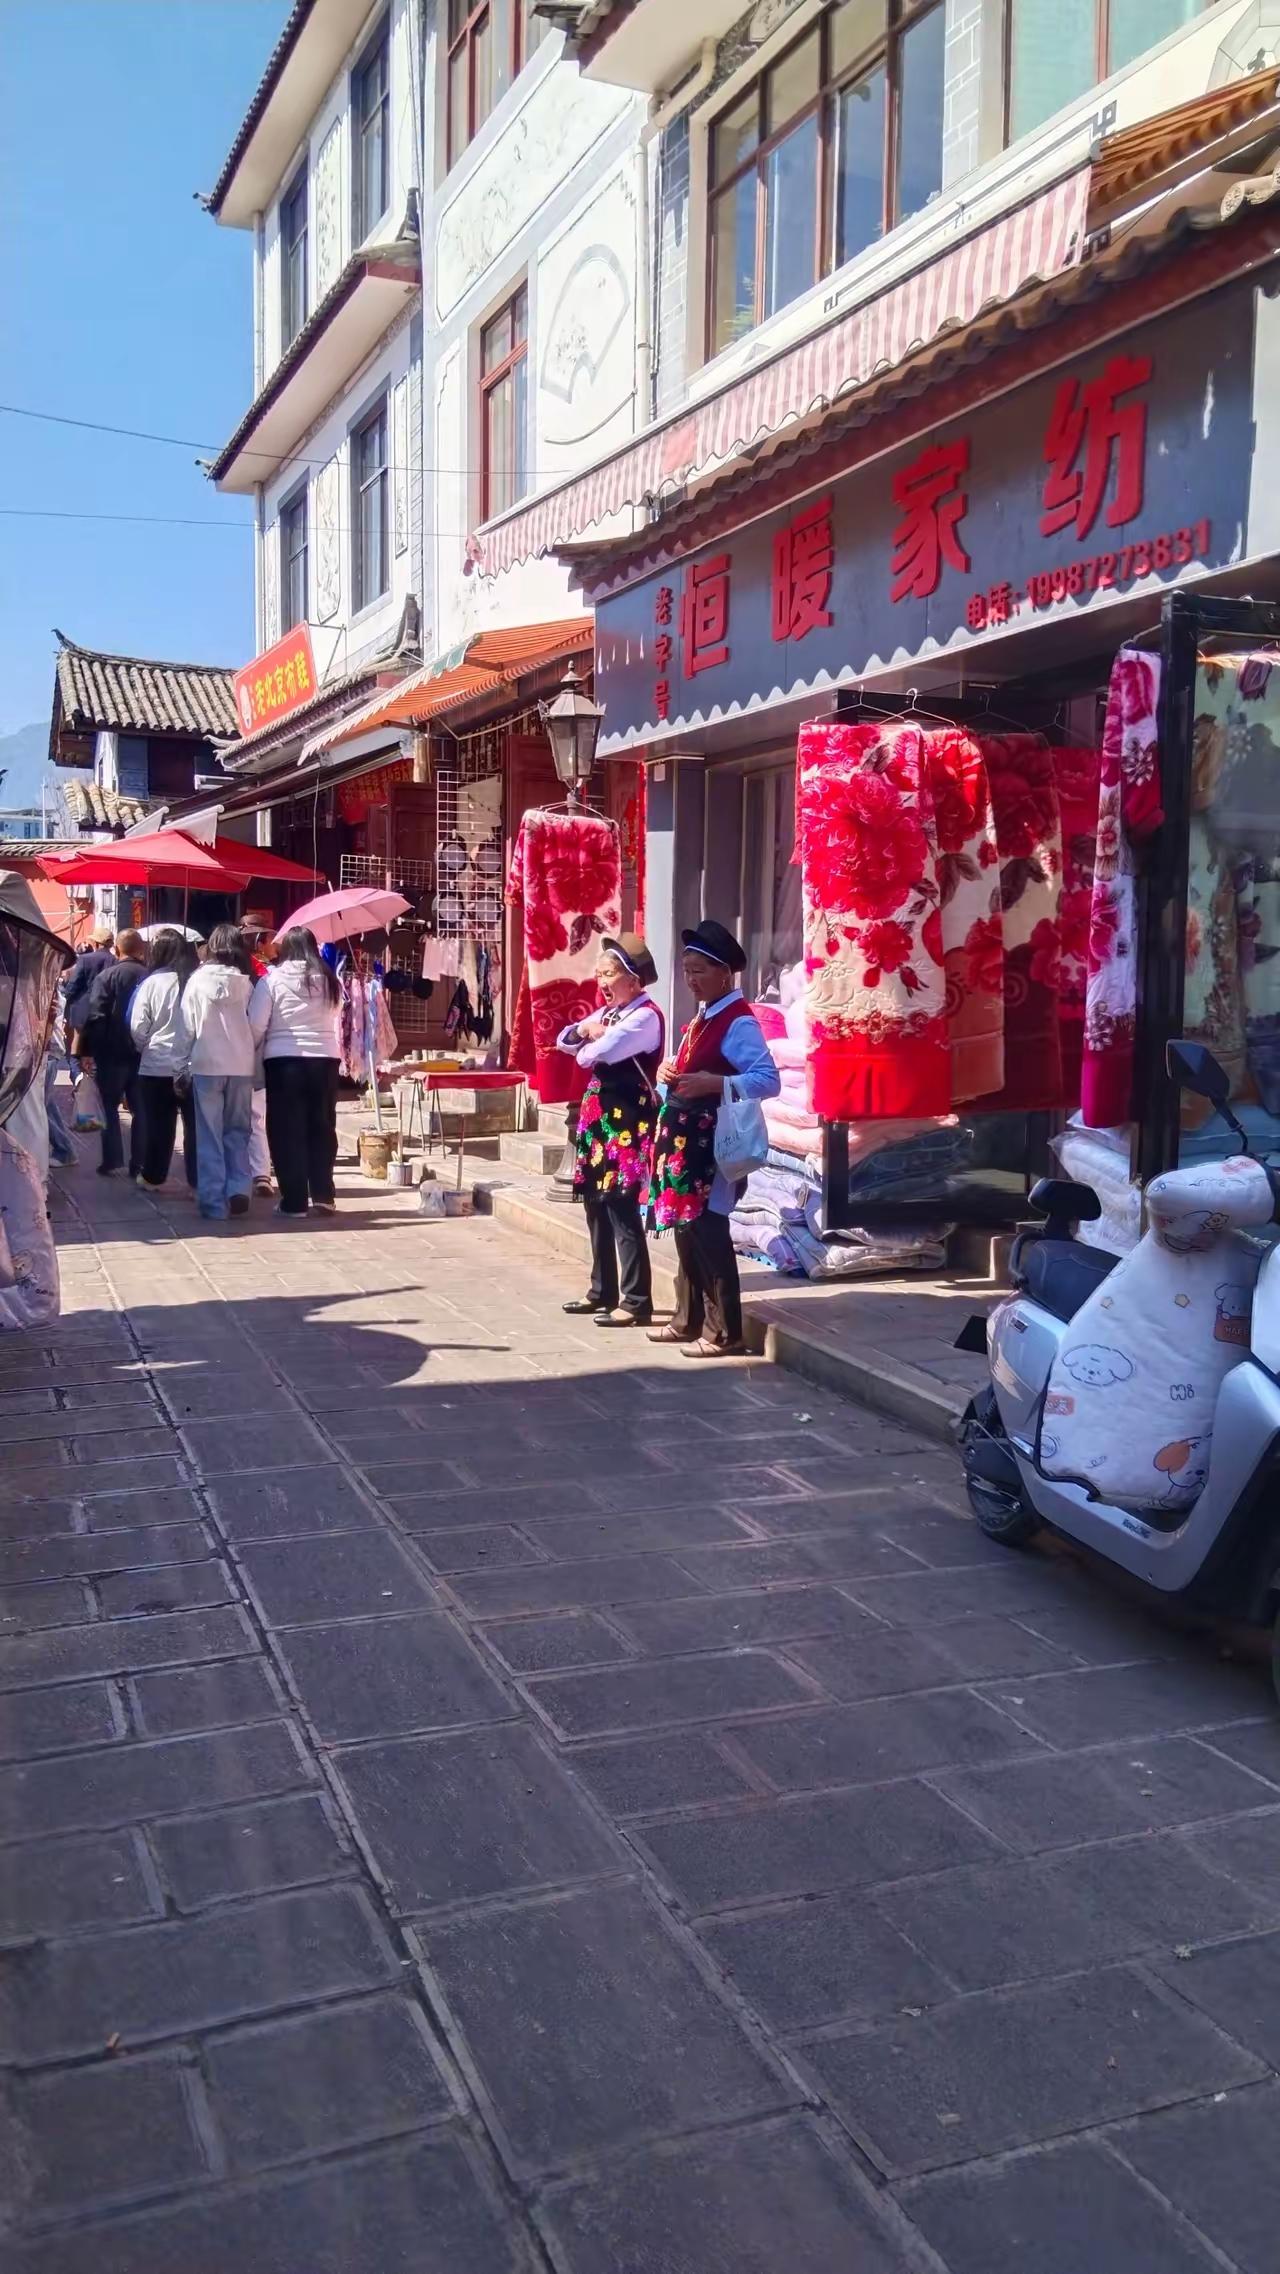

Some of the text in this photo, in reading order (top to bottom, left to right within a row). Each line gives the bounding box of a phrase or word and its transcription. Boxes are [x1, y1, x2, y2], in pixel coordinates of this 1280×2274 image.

[680, 356, 1152, 679] 恒暖家纺
[256, 651, 309, 716] 老北京布鞋
[655, 586, 673, 720] 老字号
[1170, 1383, 1195, 1401] Hi
